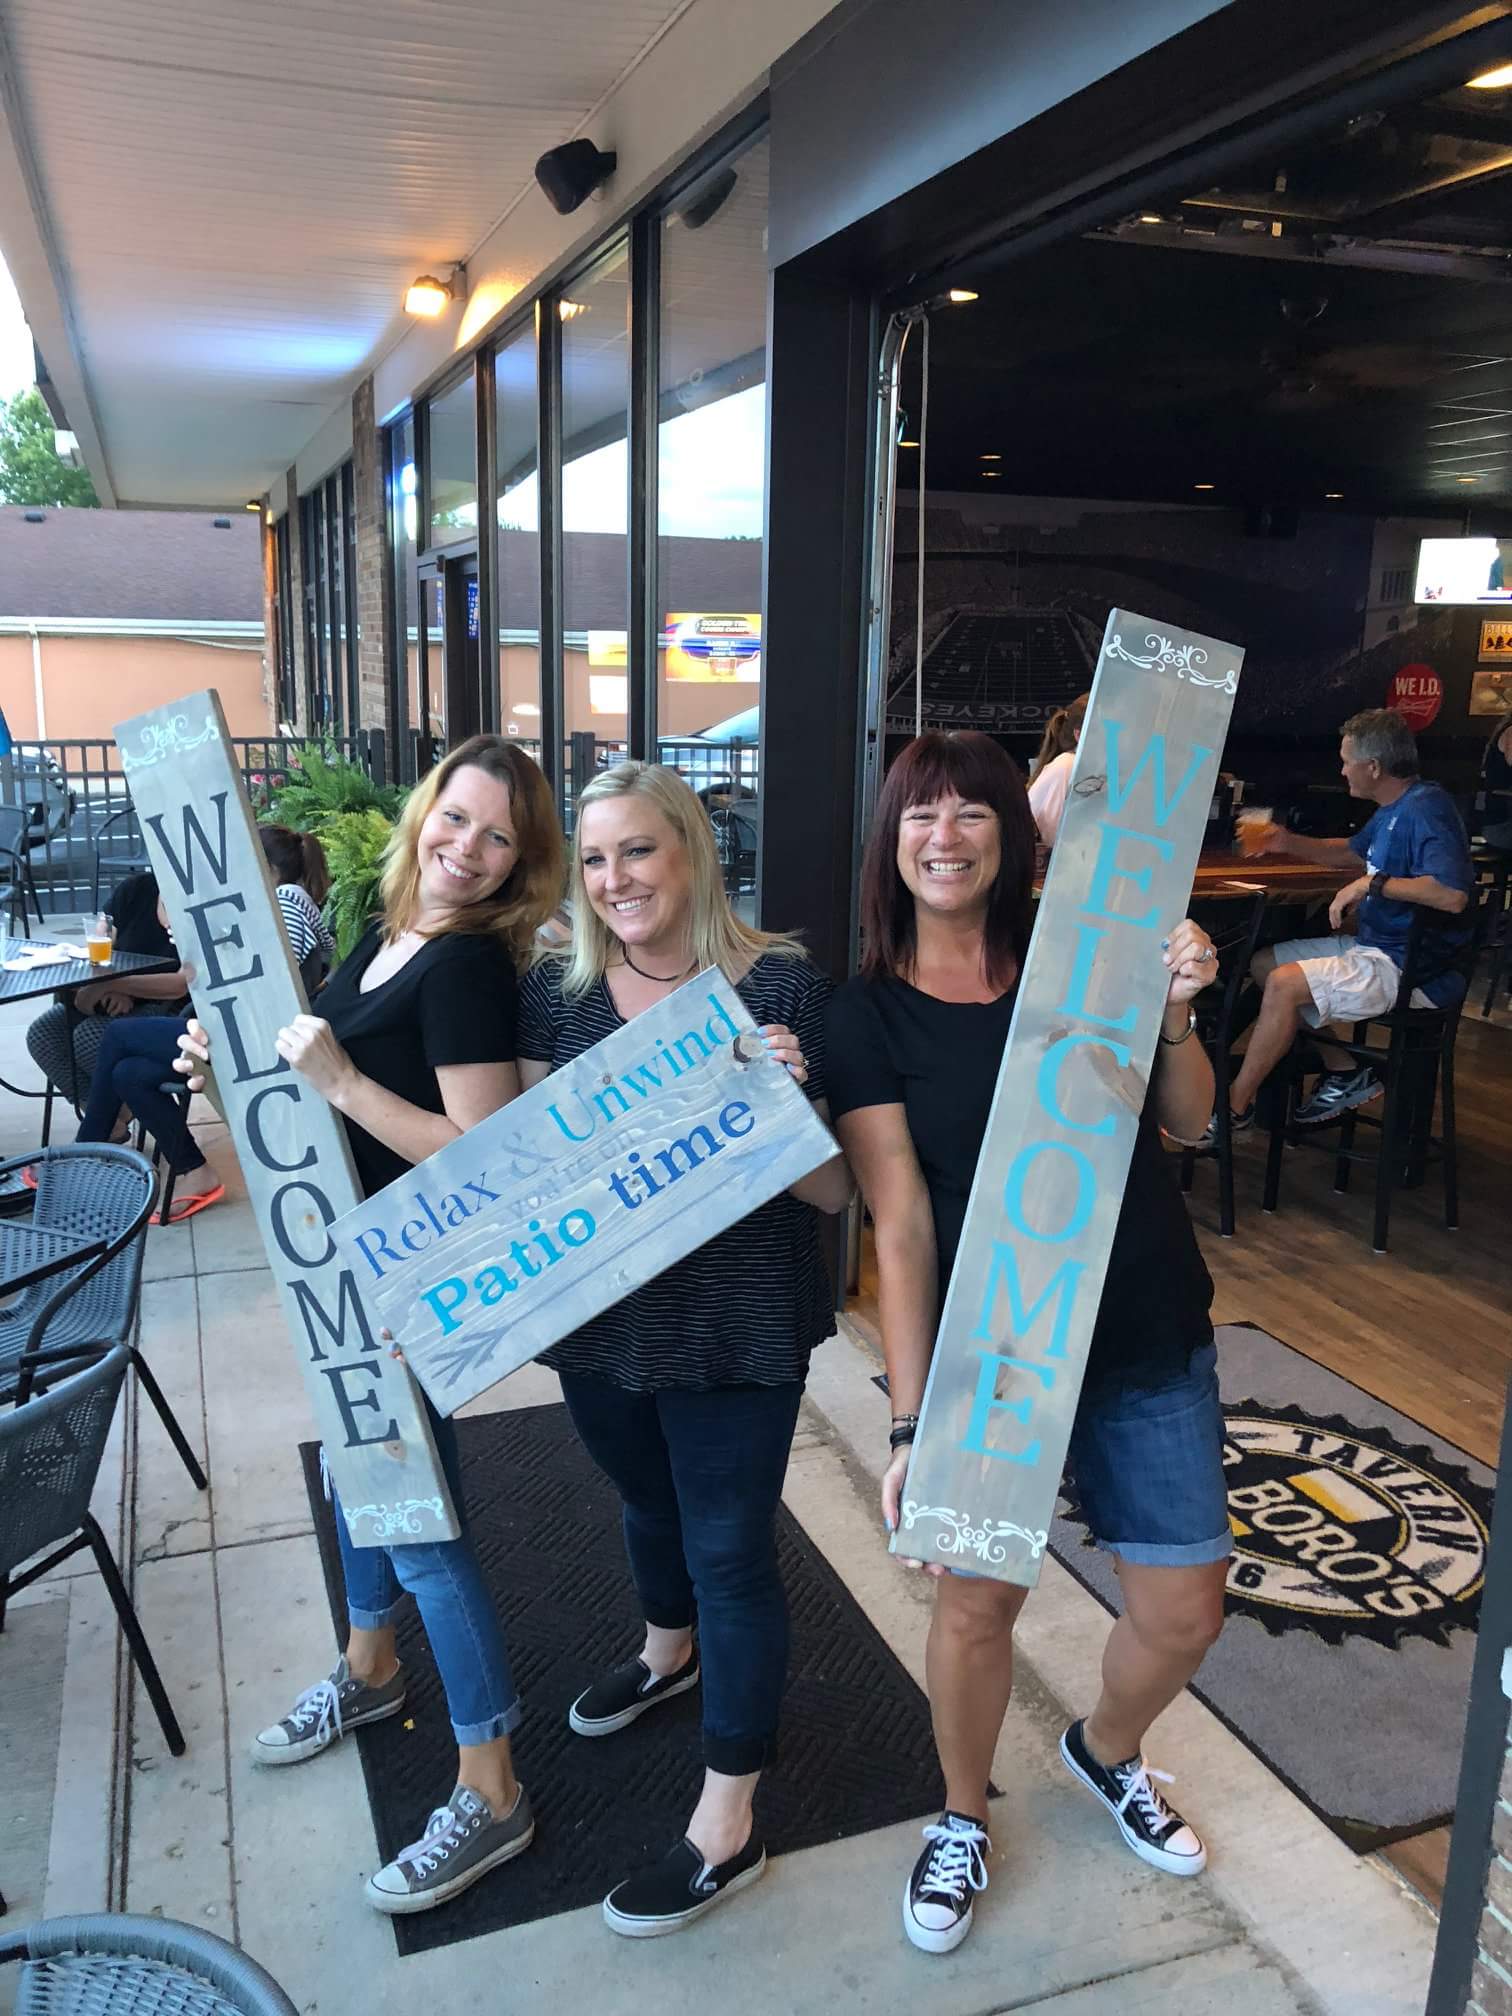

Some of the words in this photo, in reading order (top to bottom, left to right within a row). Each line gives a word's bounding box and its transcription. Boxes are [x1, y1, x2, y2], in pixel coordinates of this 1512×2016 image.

[1395, 677, 1417, 696] WE
[1419, 677, 1441, 696] I.D.
[144, 790, 400, 1449] WELCOME
[353, 1171, 502, 1281] Relax
[502, 1130, 563, 1180] &
[544, 992, 742, 1143] Unwind
[958, 717, 1213, 1468] WELCOME
[420, 1206, 598, 1338] Patio
[607, 1099, 757, 1211] time
[1227, 1479, 1445, 1618] BORO'S
[1292, 1429, 1480, 1554] TAVERN
